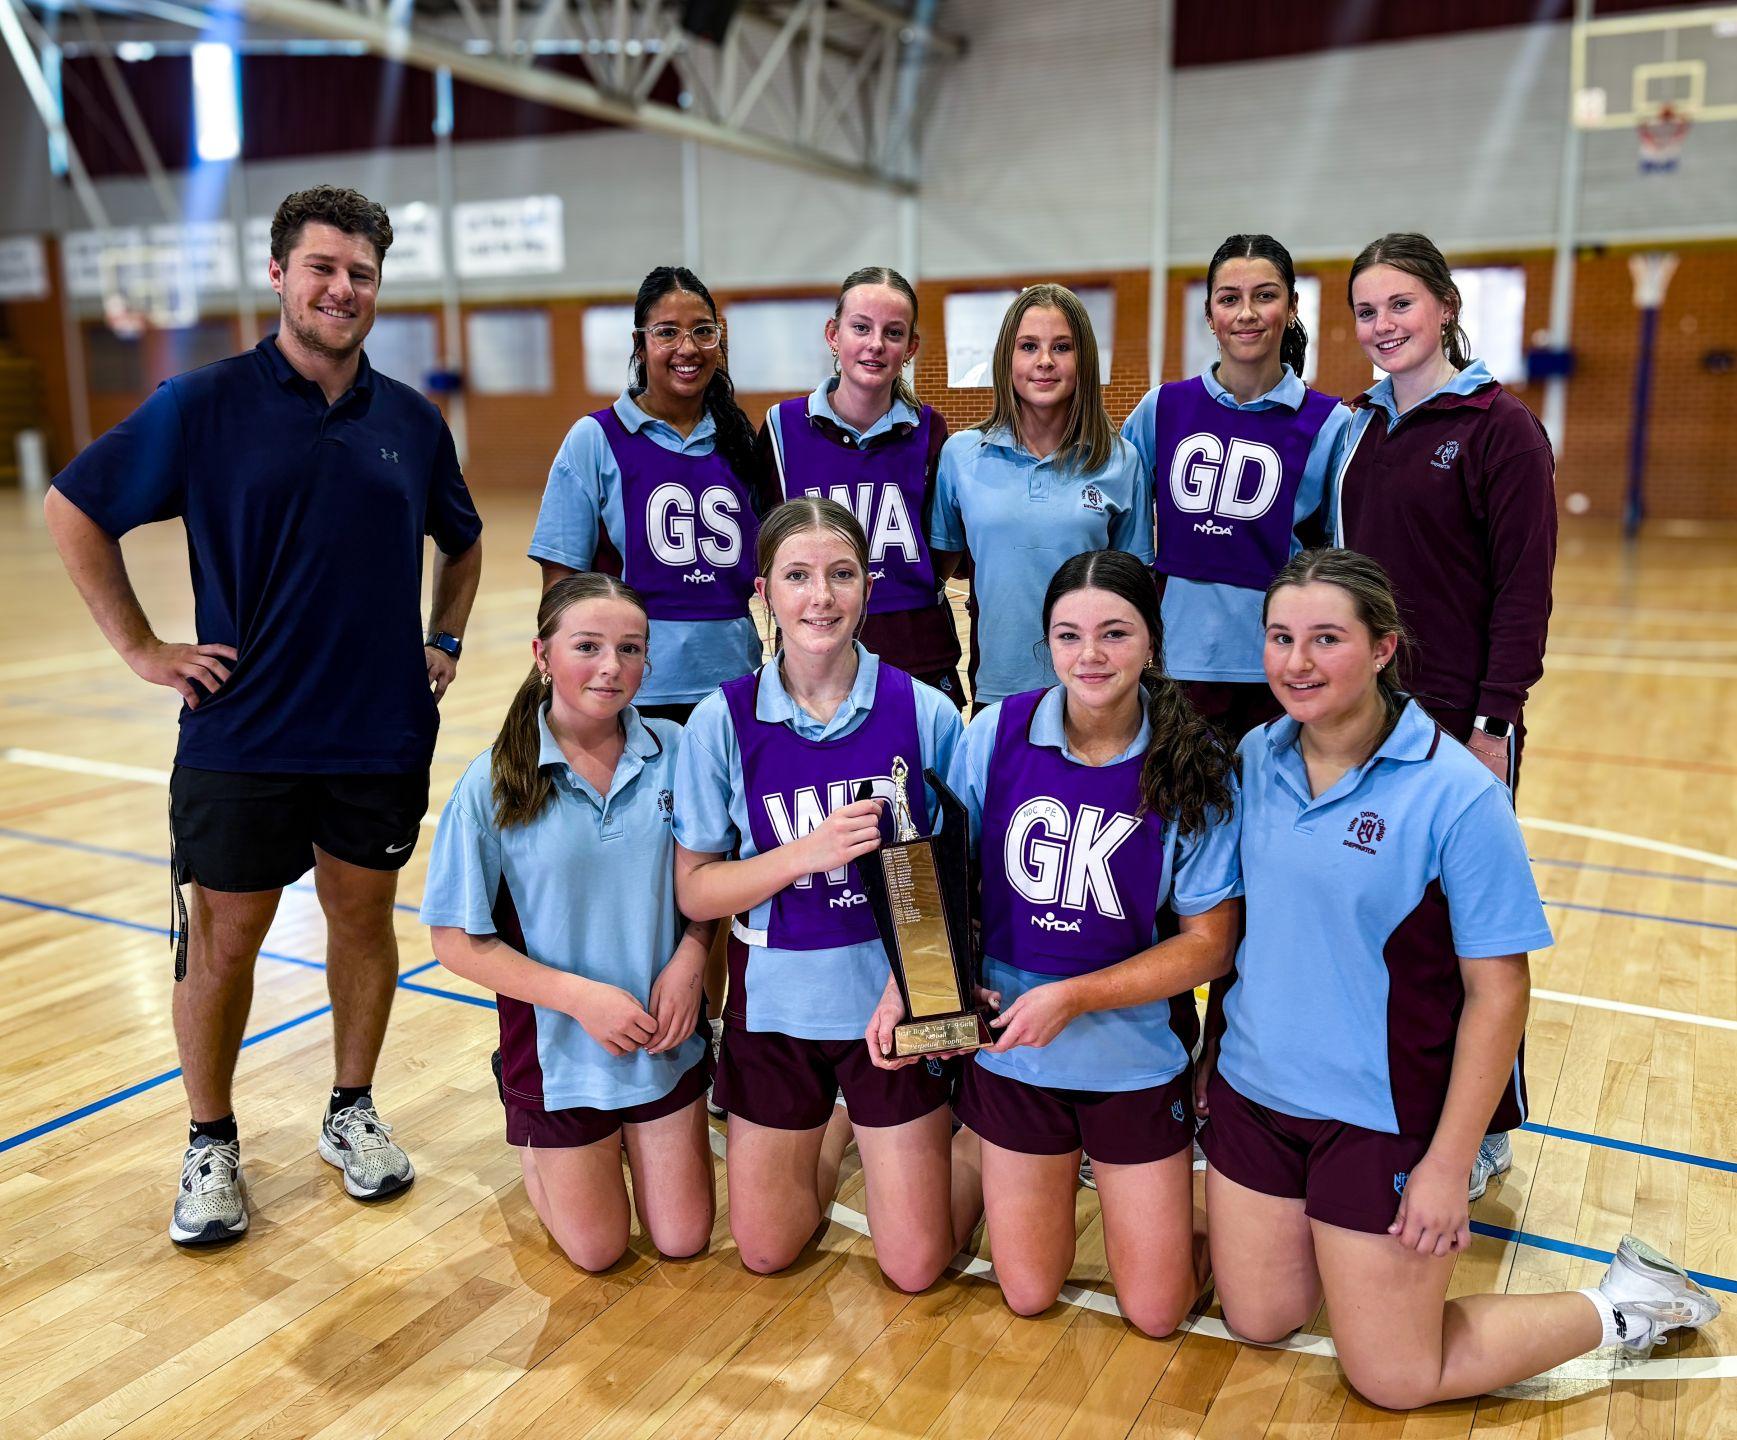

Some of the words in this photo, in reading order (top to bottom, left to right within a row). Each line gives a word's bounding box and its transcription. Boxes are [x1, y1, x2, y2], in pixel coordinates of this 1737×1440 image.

[1169, 432, 1283, 521] GD
[646, 482, 742, 568] GS
[1193, 519, 1234, 536] NYDA
[683, 568, 716, 584] NYDA
[1023, 806, 1038, 818] NDC
[1044, 806, 1057, 818] PE
[1004, 796, 1143, 920] GK
[829, 889, 868, 908] NYD
[1031, 912, 1083, 933] NYDA
